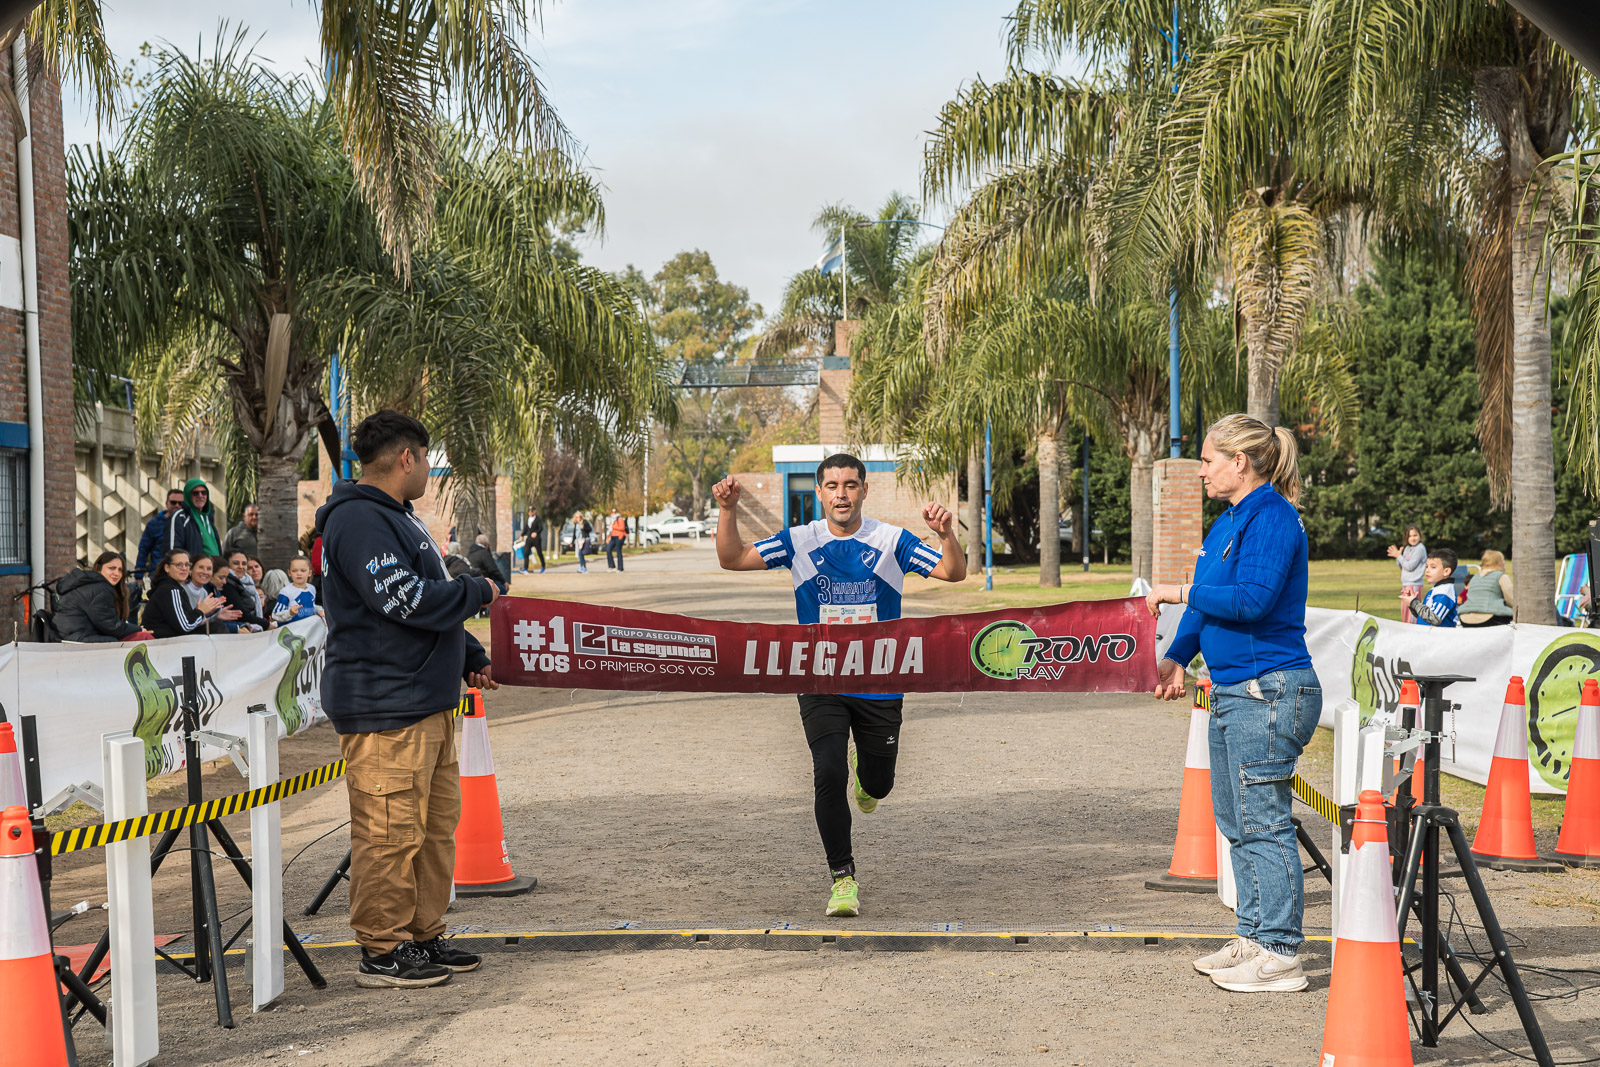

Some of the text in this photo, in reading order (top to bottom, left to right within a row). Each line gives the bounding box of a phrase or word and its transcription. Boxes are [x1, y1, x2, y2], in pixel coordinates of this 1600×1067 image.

[366, 556, 380, 575] El
[816, 574, 877, 605] 3 MARATÓN
[513, 616, 569, 653] #1
[611, 628, 710, 644] GRUPO ASEGURADOR
[633, 642, 711, 659] segunda
[743, 636, 924, 677] LLEGADA
[520, 653, 570, 673] VOS
[578, 659, 715, 676] LO PRIMERO SOS VOS
[1015, 665, 1066, 680] RAV
